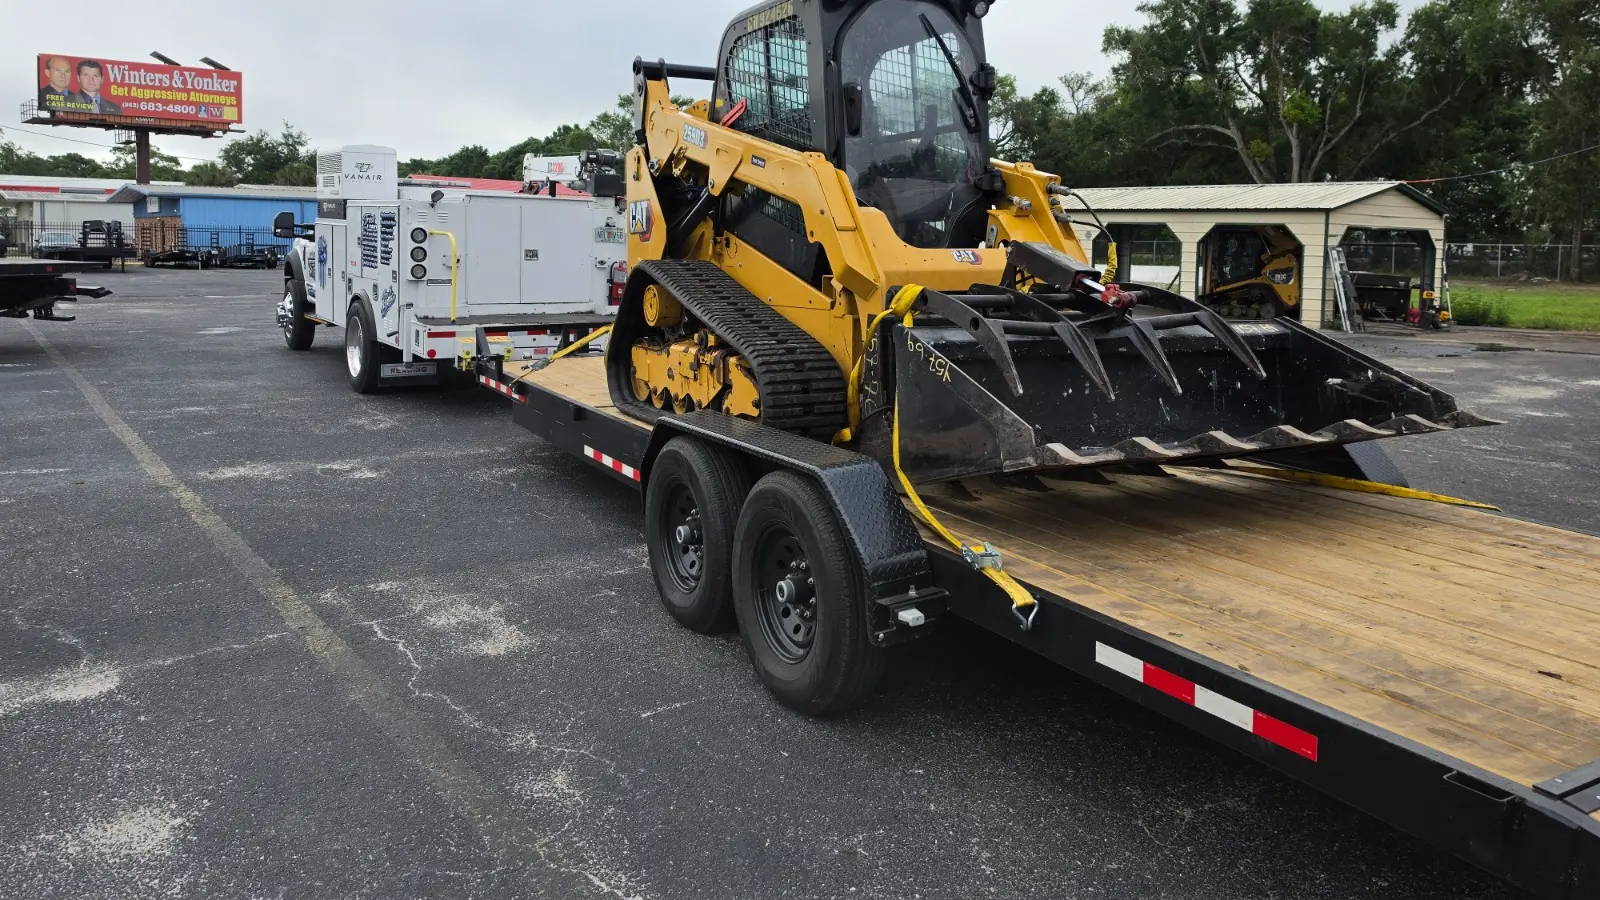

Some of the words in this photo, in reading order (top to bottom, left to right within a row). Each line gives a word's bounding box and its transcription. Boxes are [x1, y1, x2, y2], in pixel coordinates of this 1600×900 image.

[105, 64, 170, 87] Winters
[172, 70, 184, 88] &
[183, 71, 237, 93] Yonker
[110, 85, 128, 97] Get
[131, 86, 188, 101] Aggressive
[189, 91, 237, 106] Attorneys
[67, 102, 95, 110] REVIEW
[140, 101, 196, 114] 683-4800
[210, 107, 222, 117] W
[344, 173, 382, 181] VANAIR
[629, 201, 648, 234] CAT
[952, 249, 976, 263] CAT
